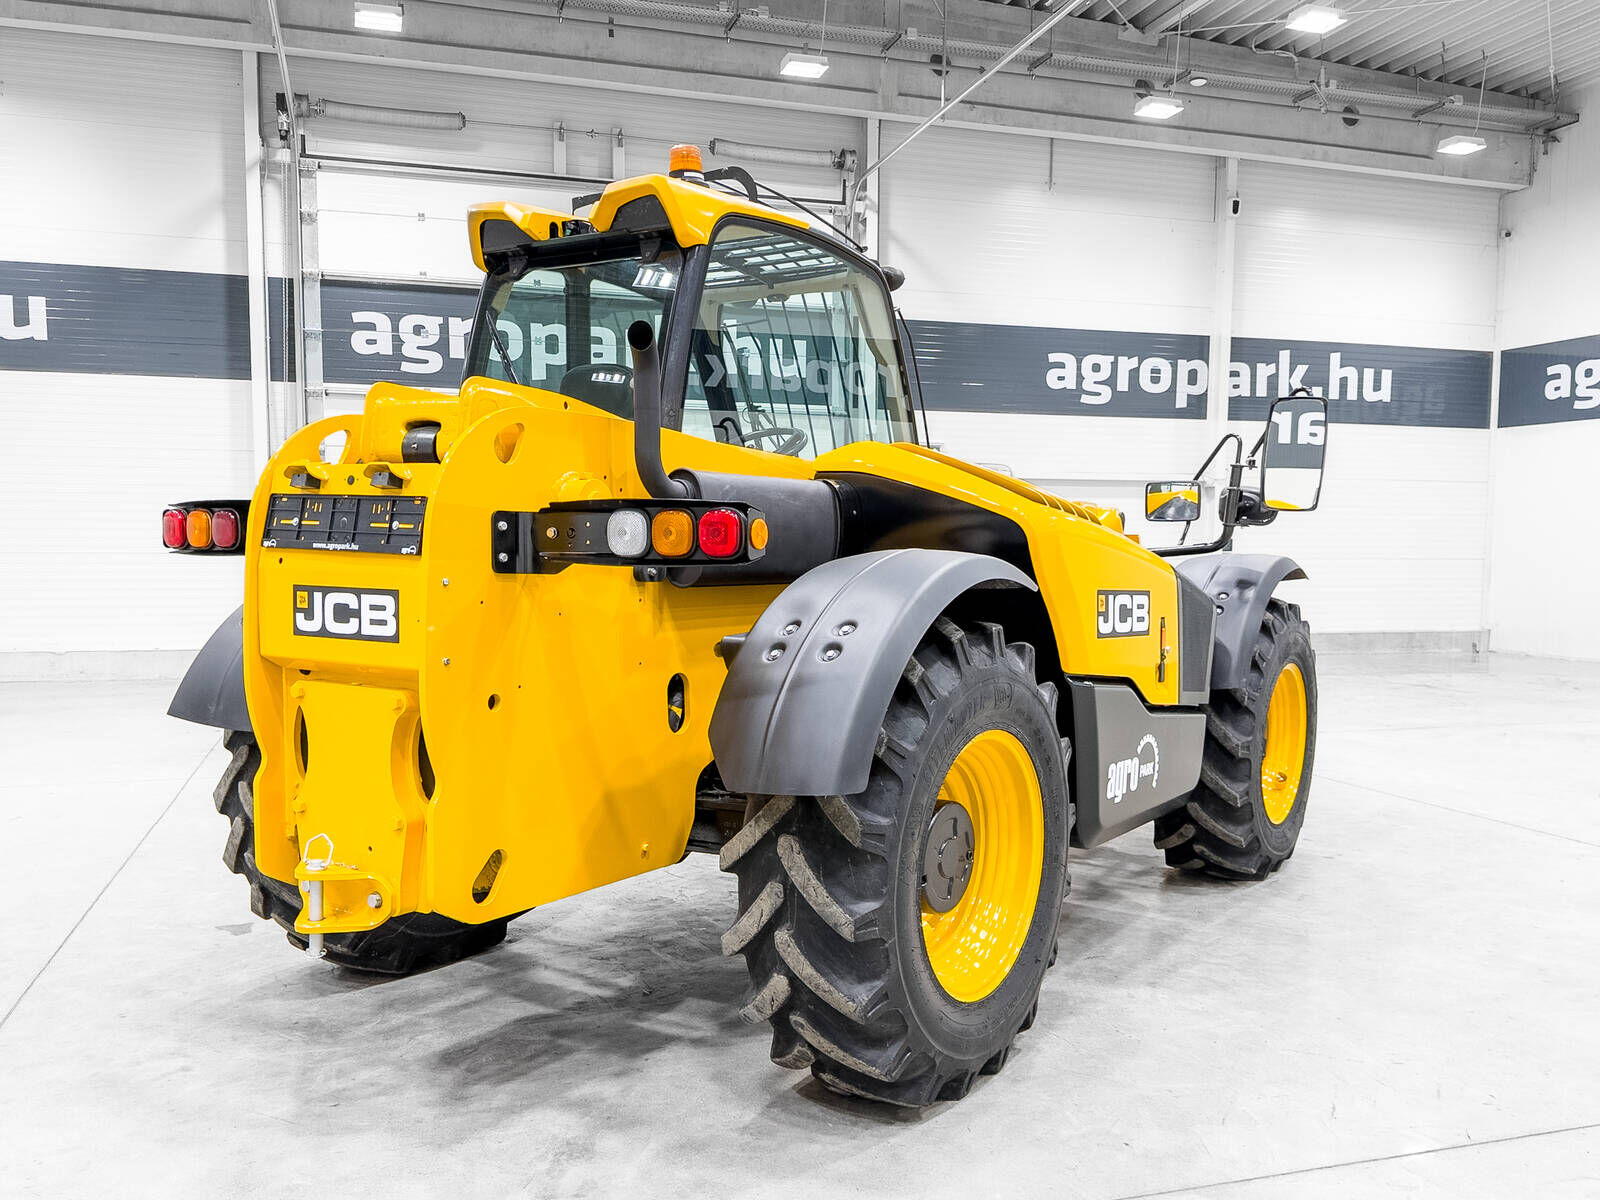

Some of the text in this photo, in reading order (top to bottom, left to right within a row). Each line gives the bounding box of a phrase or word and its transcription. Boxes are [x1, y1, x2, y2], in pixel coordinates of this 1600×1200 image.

[295, 591, 398, 637] JCB
[1098, 594, 1150, 634] JCB
[1106, 756, 1139, 804] agro
